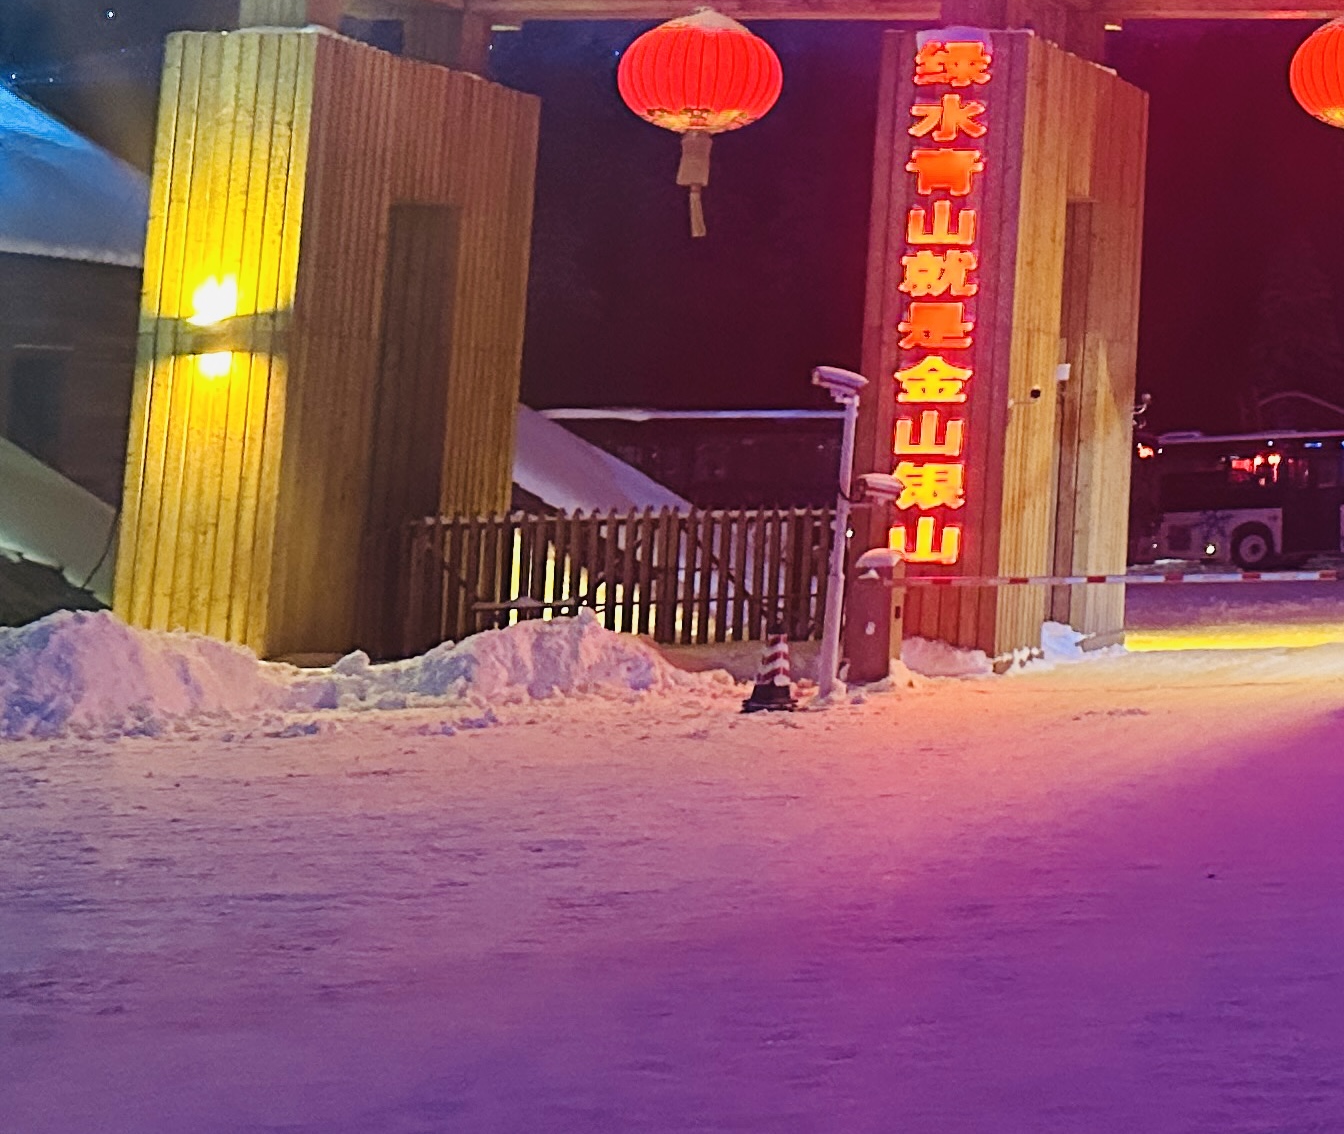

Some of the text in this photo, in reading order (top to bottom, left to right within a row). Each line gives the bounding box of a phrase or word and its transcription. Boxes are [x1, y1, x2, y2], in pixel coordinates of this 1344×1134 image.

[889, 40, 991, 565] 绿水青山就是金山银山
